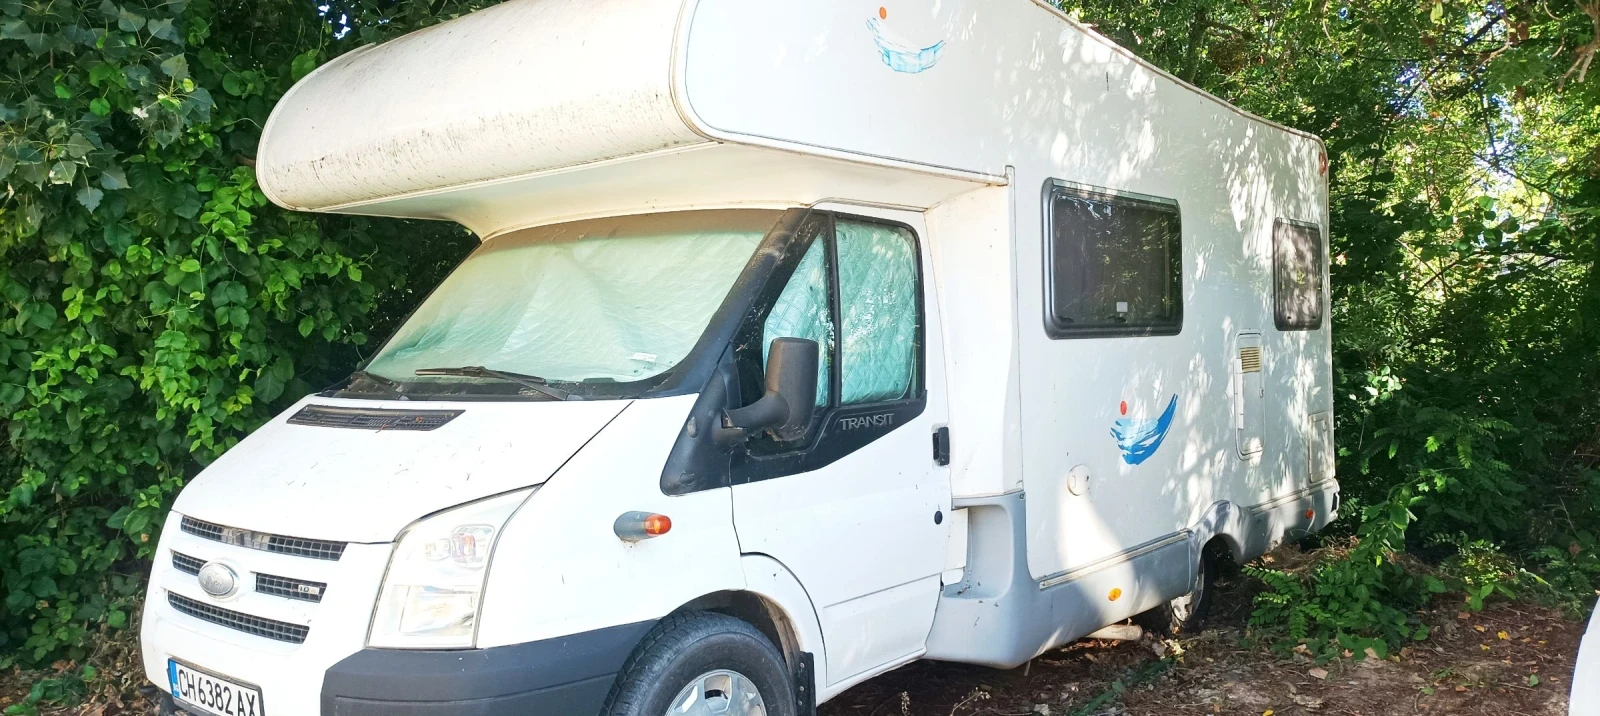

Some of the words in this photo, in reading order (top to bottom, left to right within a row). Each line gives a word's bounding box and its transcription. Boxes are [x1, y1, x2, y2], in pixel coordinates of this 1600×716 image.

[840, 413, 894, 430] TRANSIT
[178, 669, 196, 701] CH
[198, 677, 234, 716] 6382
[237, 690, 255, 716] AX
